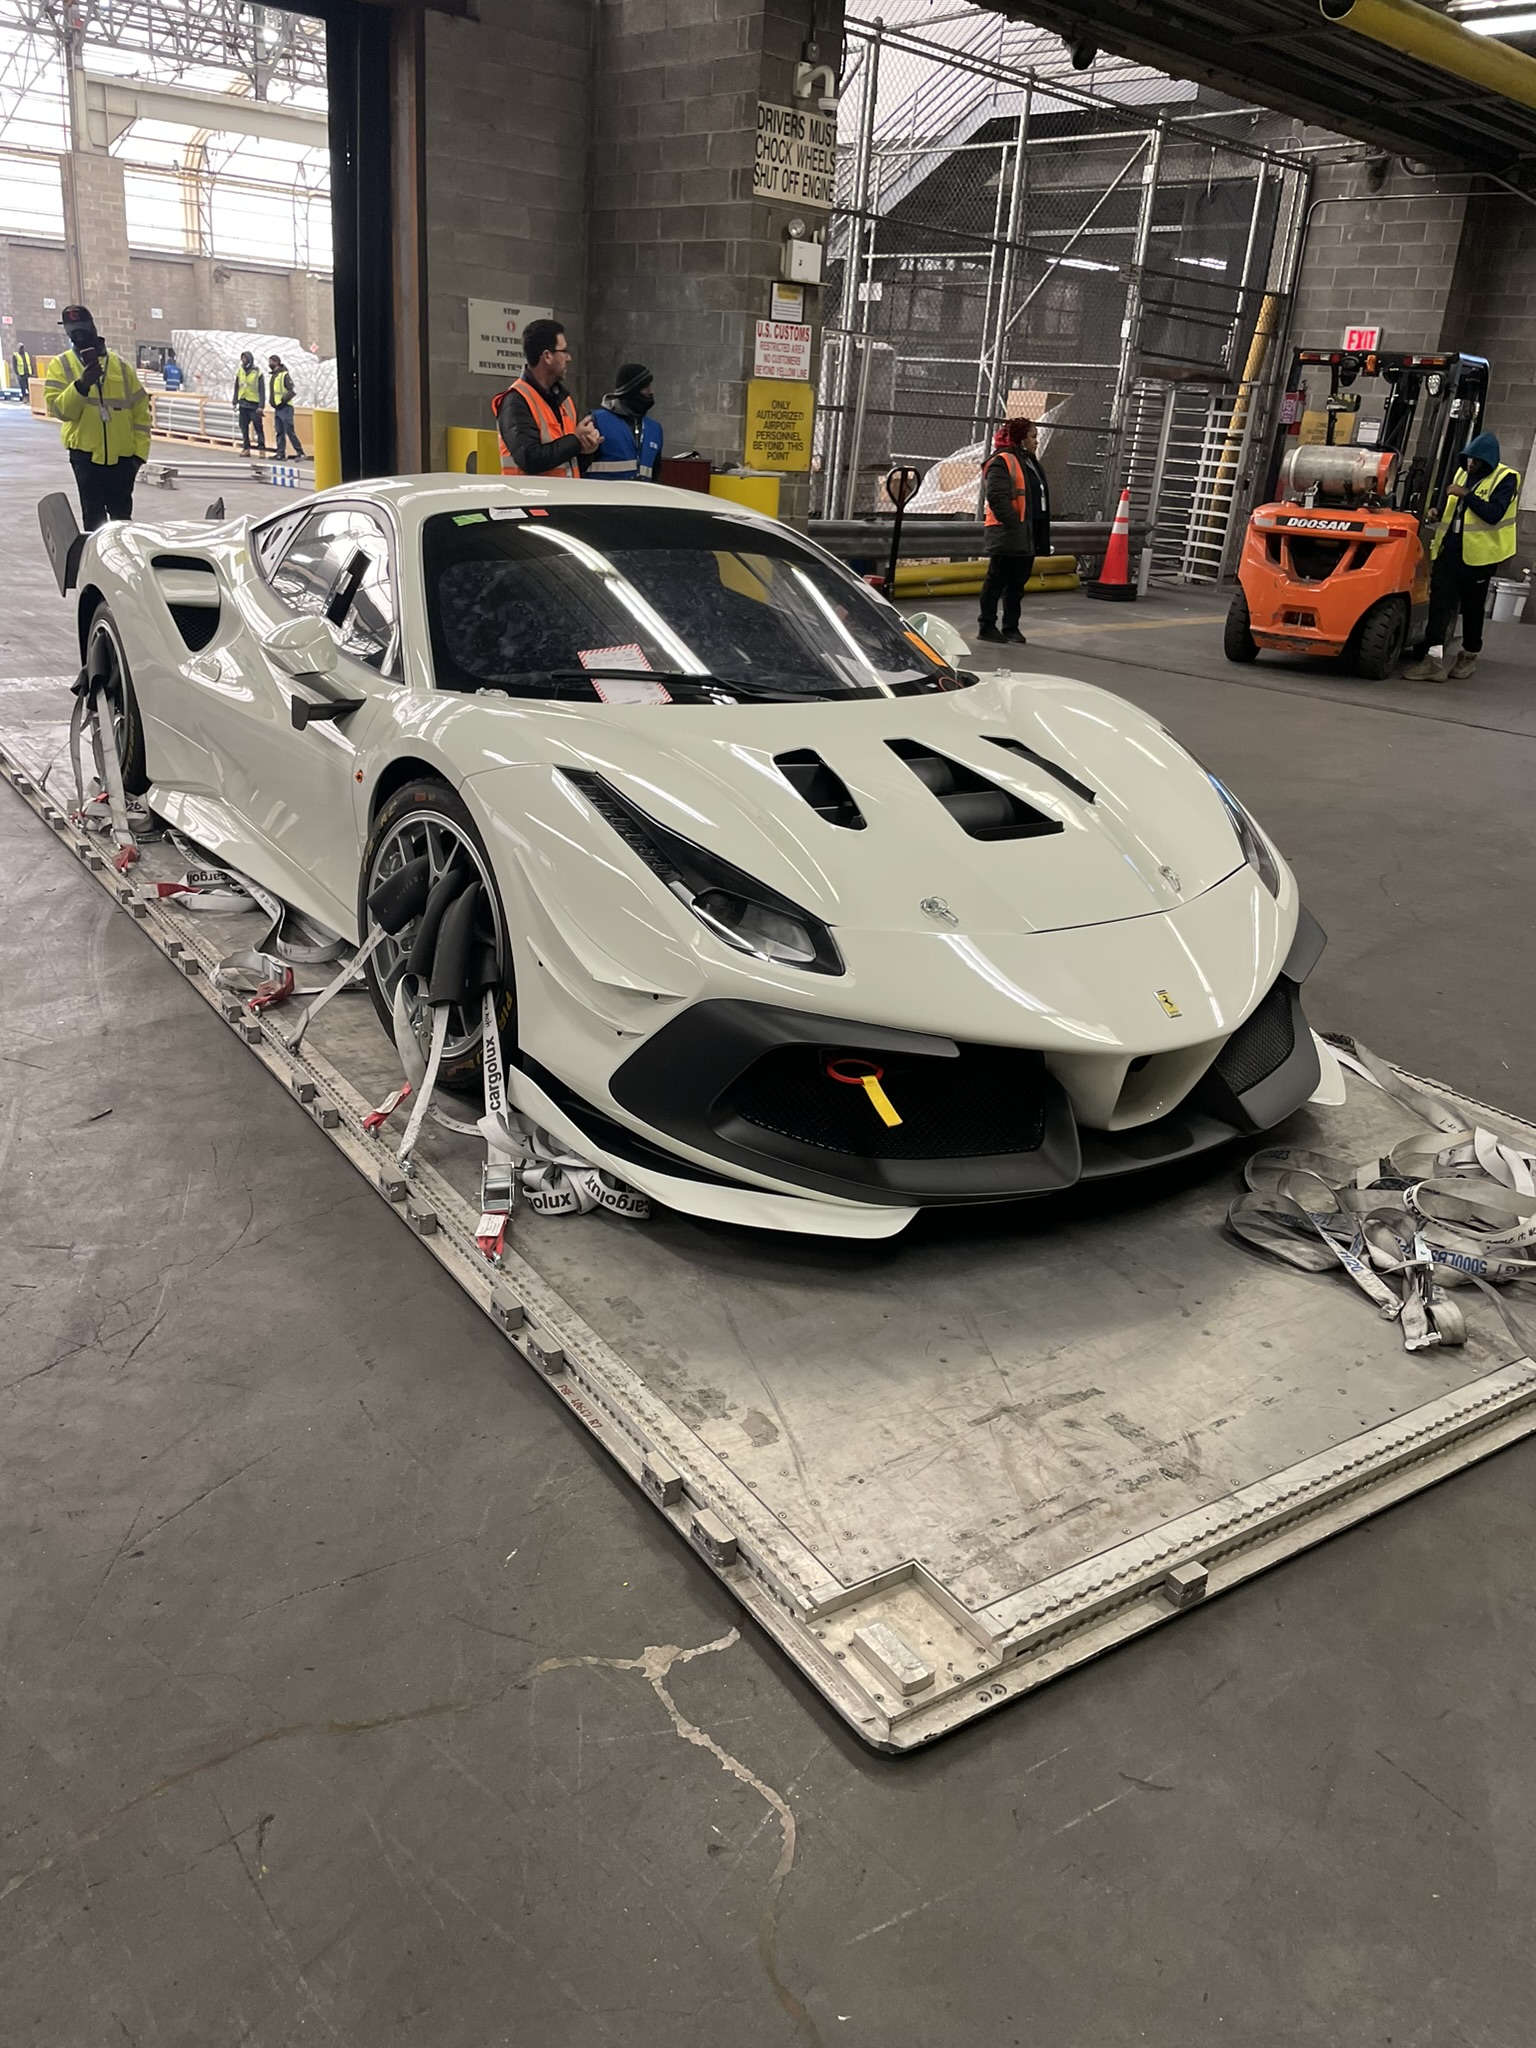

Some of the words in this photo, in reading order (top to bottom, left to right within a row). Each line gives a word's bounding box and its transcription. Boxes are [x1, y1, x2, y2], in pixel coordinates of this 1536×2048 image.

[758, 106, 805, 140] DRIVERS
[809, 119, 838, 148] MUST
[755, 134, 793, 166] CHOCK
[797, 144, 836, 175] WHEELS
[753, 162, 779, 190] SHUT
[782, 168, 800, 194] OFF
[802, 174, 835, 202] ENGINE
[503, 308, 520, 316] STOP
[757, 322, 772, 338] U.S.
[774, 324, 810, 342] CUSTOMS
[1347, 330, 1377, 351] EXIT
[760, 341, 790, 353] RESTRICTED
[792, 344, 805, 354] AREA
[763, 353, 771, 363] NO
[772, 354, 801, 366] CUSTOMERS
[756, 365, 775, 375] BEYOND
[776, 367, 796, 377] YELLOW
[797, 369, 807, 378] LINE
[771, 400, 791, 409] ONLY
[756, 410, 804, 421] AUTHORIZED
[763, 421, 796, 430] AIRPORT
[756, 430, 802, 441] PERSONNEL
[753, 441, 785, 451] BEYOND
[787, 442, 804, 451] THIS
[767, 452, 790, 460] POINT
[1287, 517, 1351, 531] DOOSAN
[485, 1036, 502, 1111] cargolux
[585, 1175, 650, 1213] cargolux
